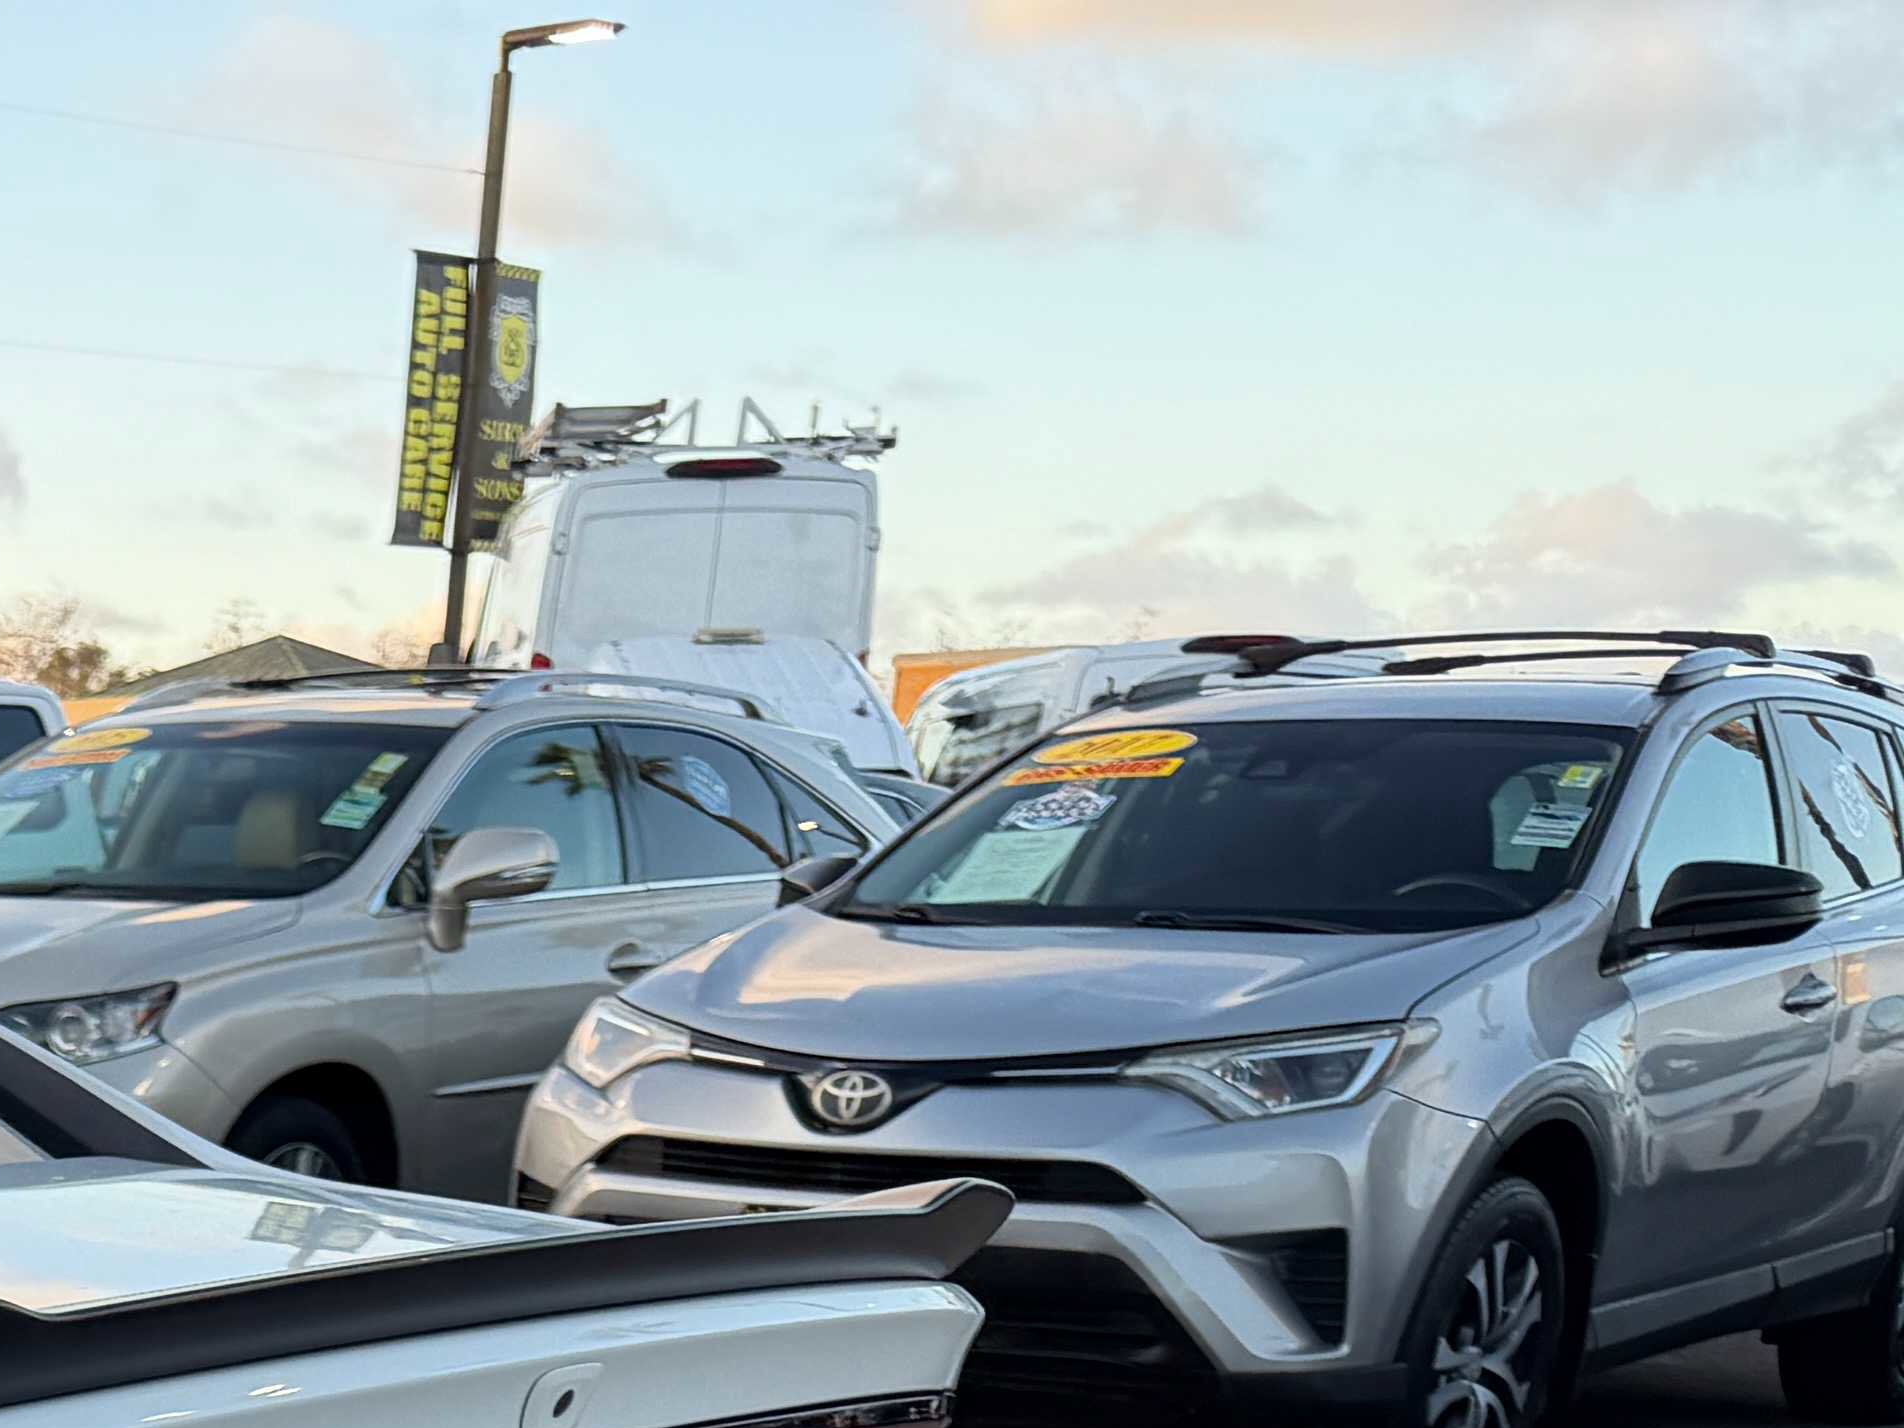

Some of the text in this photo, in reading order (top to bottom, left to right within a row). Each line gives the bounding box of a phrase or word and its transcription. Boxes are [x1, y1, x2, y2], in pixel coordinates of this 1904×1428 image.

[398, 288, 441, 512] AUTO CARE
[418, 265, 468, 542] FULL SERVICE
